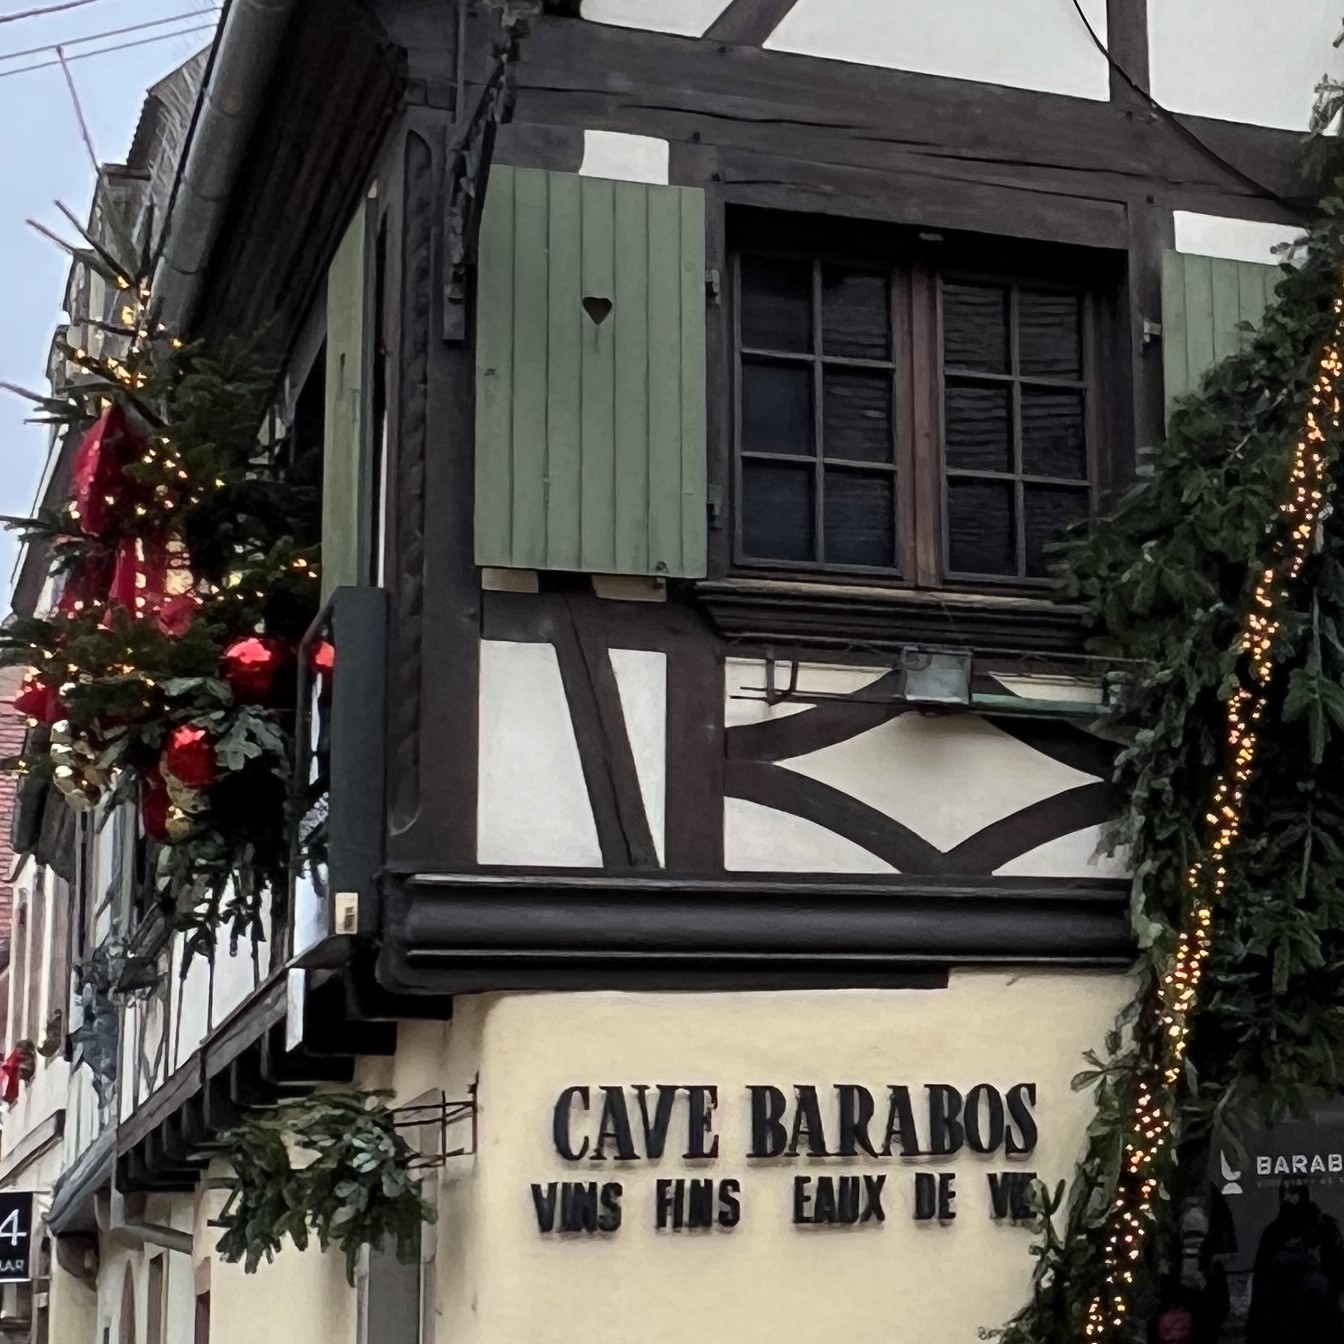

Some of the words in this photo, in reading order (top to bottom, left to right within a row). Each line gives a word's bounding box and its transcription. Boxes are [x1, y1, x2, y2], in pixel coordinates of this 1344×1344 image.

[553, 1084, 719, 1161] CAVE
[746, 1082, 1038, 1159] BARABOS
[531, 1181, 623, 1233] VINS
[656, 1178, 741, 1229] FINS
[792, 1174, 887, 1224] EAUX
[914, 1172, 957, 1221] DE
[986, 1171, 1038, 1220] VIE
